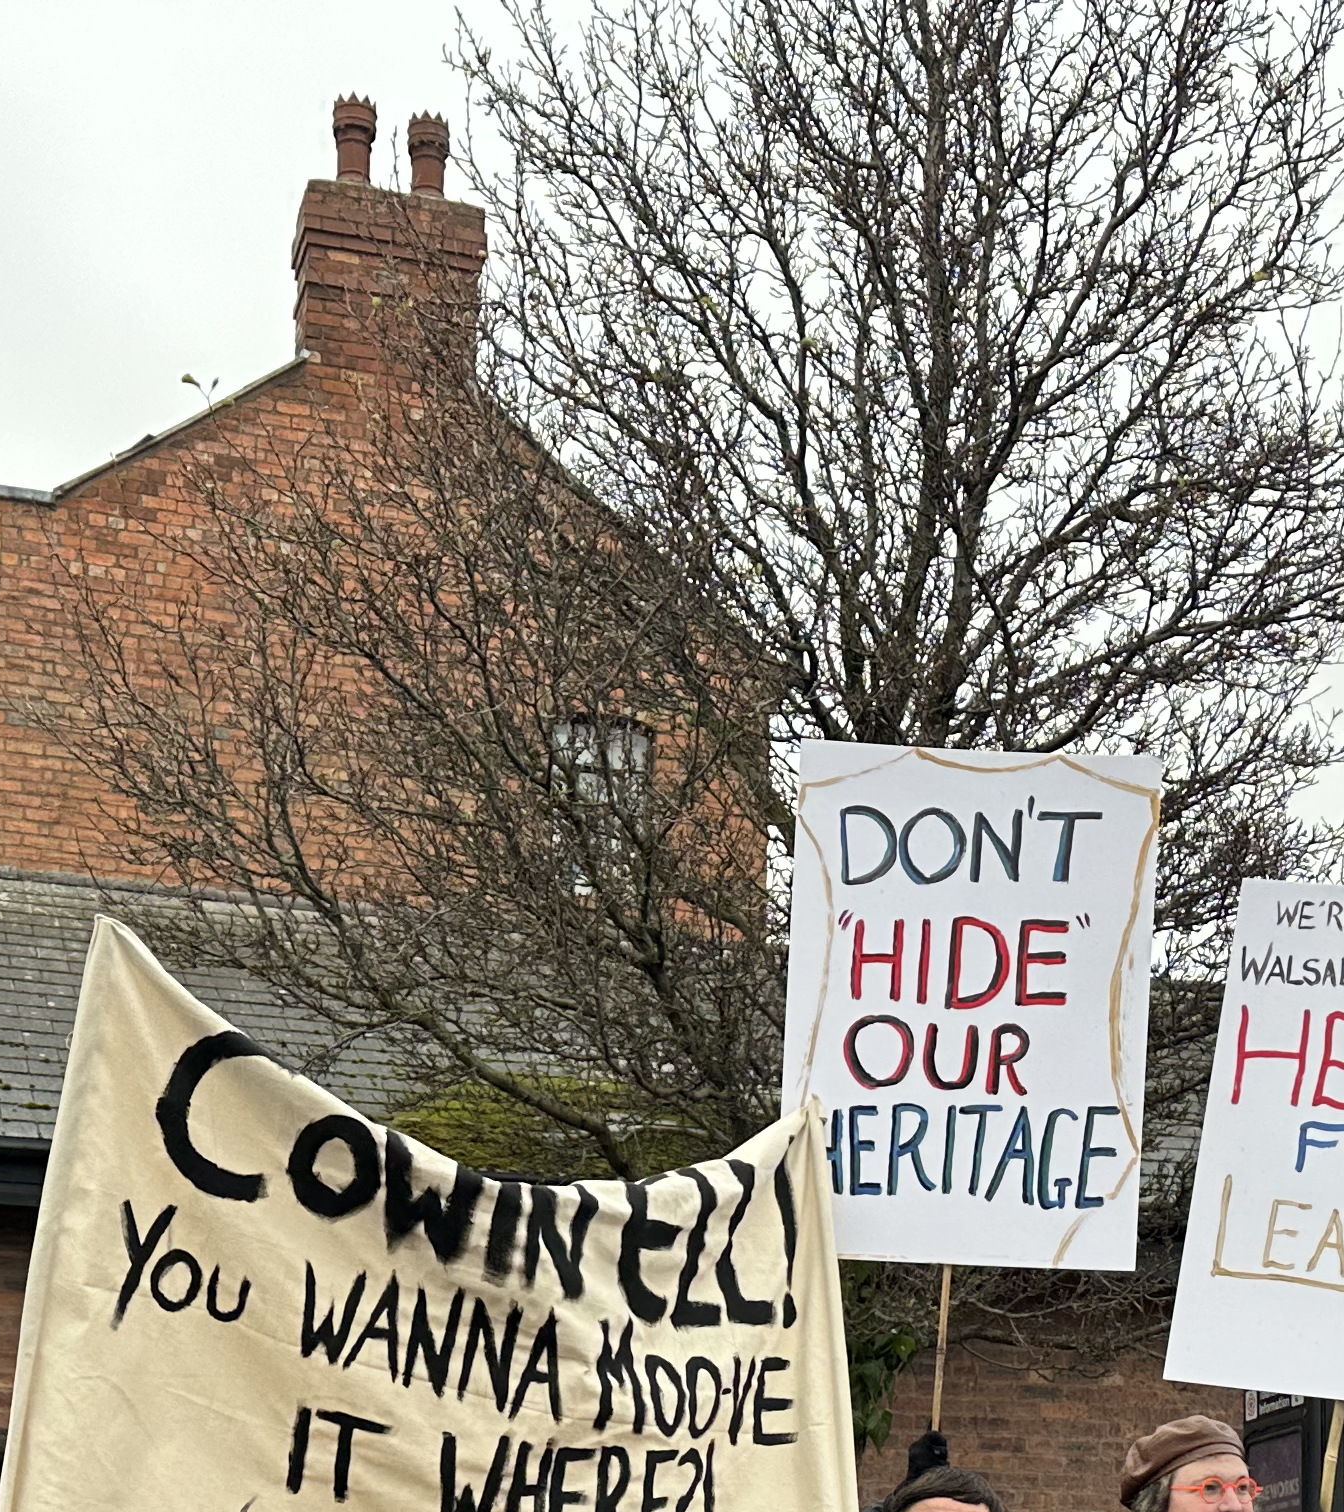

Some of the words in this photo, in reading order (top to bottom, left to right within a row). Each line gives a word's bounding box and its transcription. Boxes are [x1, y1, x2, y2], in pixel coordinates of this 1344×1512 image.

[839, 795, 1103, 886] DON'T
[838, 909, 1091, 1010] "HIDE"
[843, 1014, 1031, 1097] OUR
[301, 1260, 562, 1425] WANNA
[286, 1402, 394, 1503] IT
